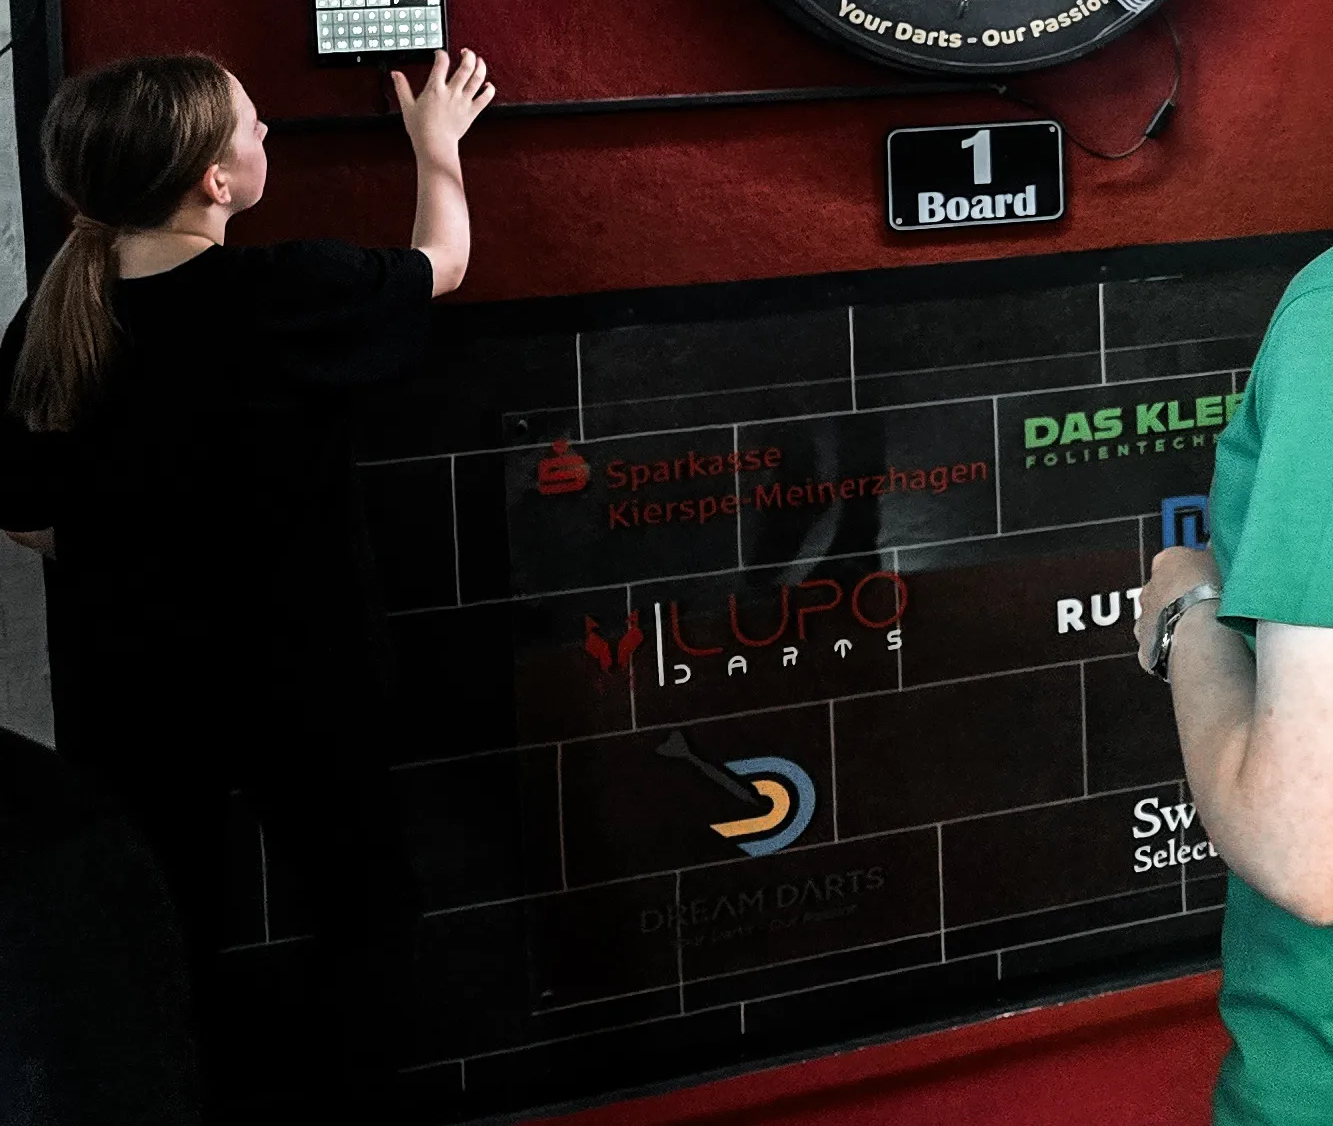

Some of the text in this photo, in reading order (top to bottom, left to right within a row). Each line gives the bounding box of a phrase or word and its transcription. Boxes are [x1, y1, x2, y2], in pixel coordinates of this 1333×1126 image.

[894, 20, 963, 49] Darts
[981, 23, 1026, 47] Our
[961, 129, 992, 185] 1
[917, 184, 1037, 224] Board
[1023, 407, 1123, 450] DAS
[606, 442, 783, 490] Sparkasse
[608, 457, 990, 530] Kierspe-Meinerzhagen
[670, 571, 908, 658] LUPO
[639, 886, 765, 935] DREAM
[775, 865, 888, 909] DARTS
